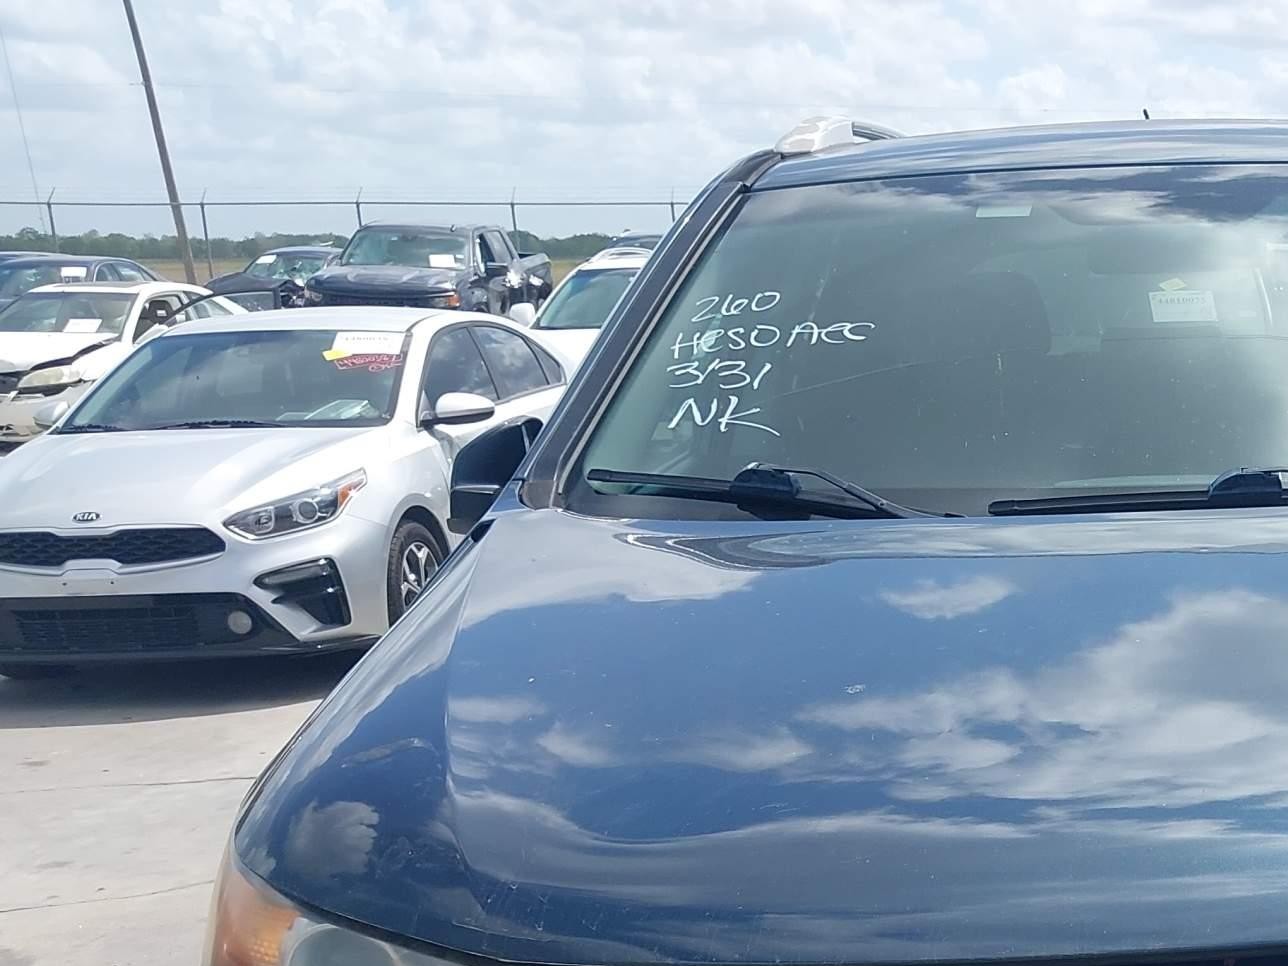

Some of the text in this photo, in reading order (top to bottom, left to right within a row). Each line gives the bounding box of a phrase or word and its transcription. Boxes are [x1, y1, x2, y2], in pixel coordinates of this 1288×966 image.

[691, 291, 780, 322] 260
[667, 358, 772, 390] 3/31
[667, 395, 781, 437] NK
